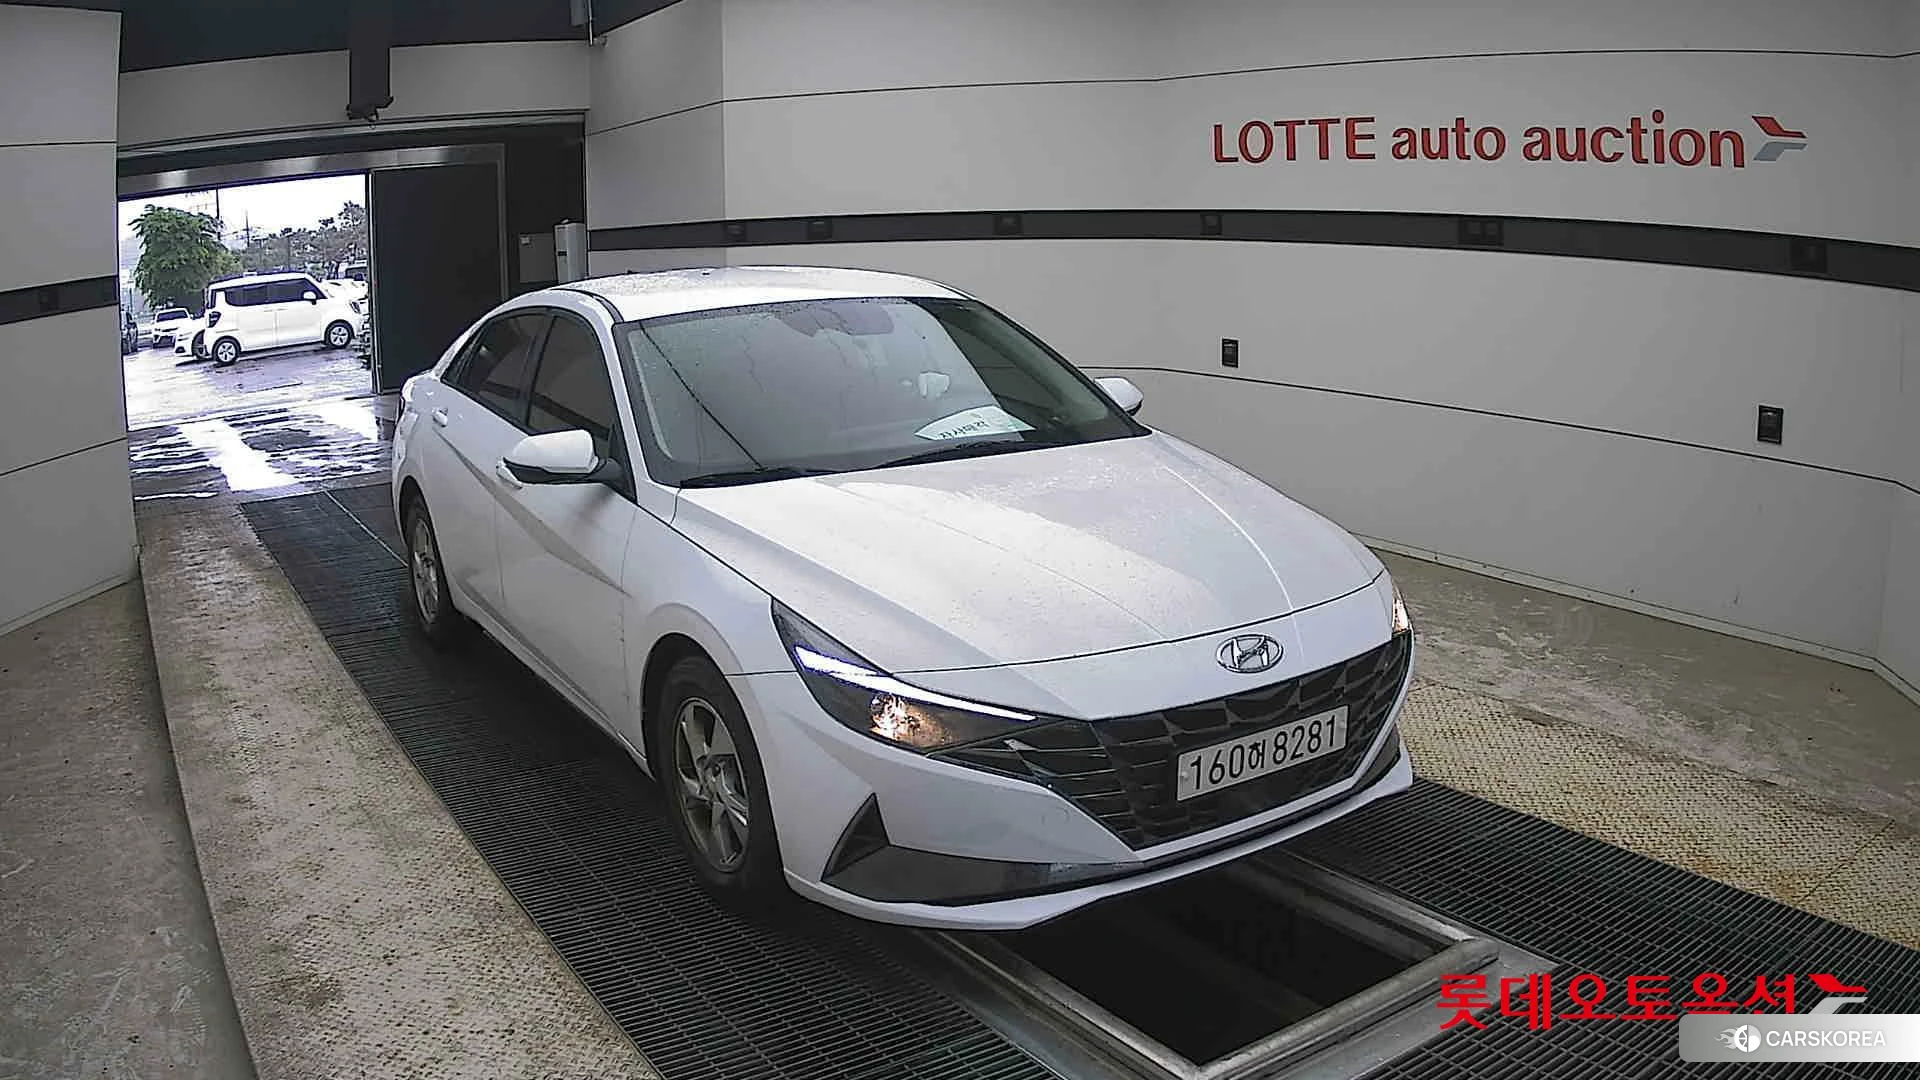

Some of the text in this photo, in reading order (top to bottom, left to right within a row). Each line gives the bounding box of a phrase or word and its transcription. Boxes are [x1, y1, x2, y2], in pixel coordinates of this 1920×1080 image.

[1212, 109, 1746, 169] LOTTE auto auction
